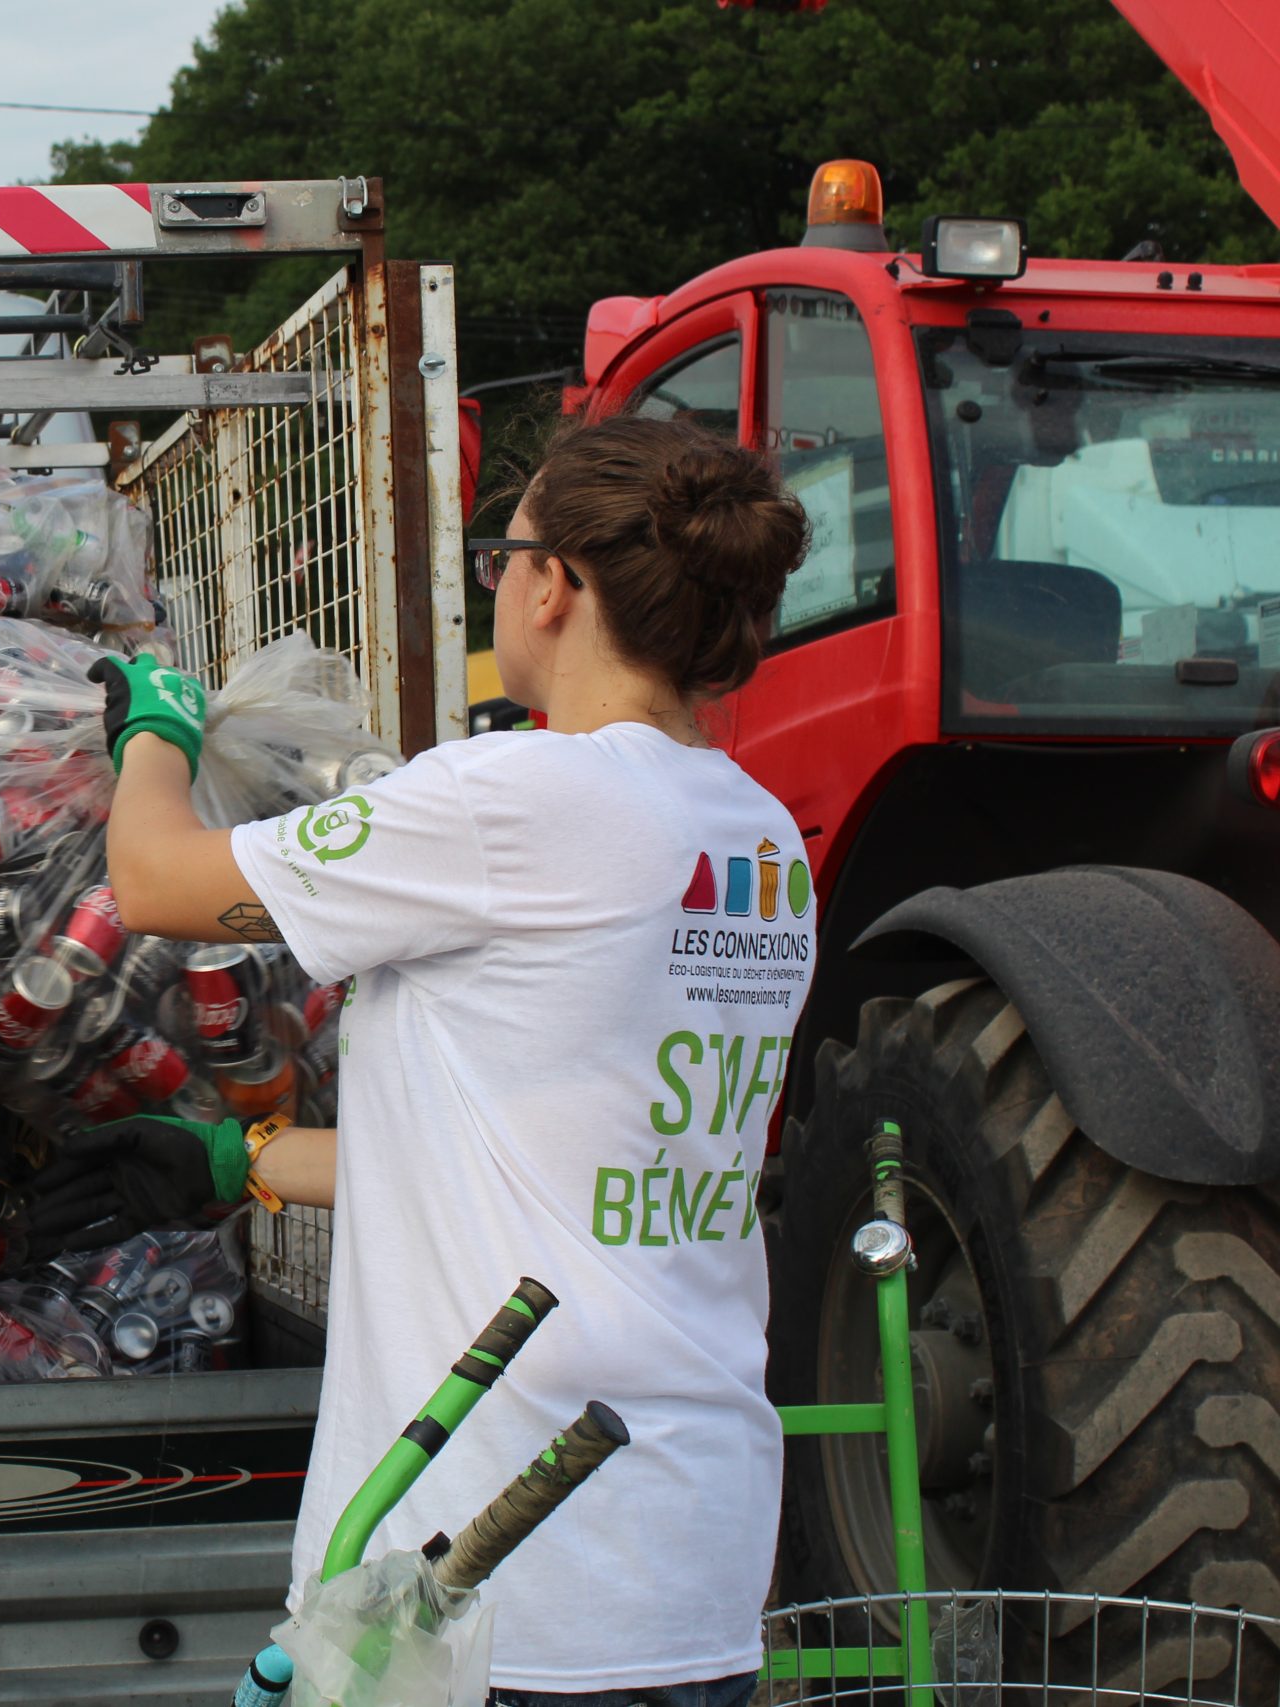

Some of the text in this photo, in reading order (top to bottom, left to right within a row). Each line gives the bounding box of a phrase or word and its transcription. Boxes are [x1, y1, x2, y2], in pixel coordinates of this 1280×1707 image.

[671, 928, 809, 962] LES CONNEXIONS
[668, 962, 731, 979] ÉCO-LOGISTIQUE
[732, 967, 742, 979] DU
[743, 966, 766, 981] DÉCHET
[686, 983, 792, 1009] www.lesconnexions.org
